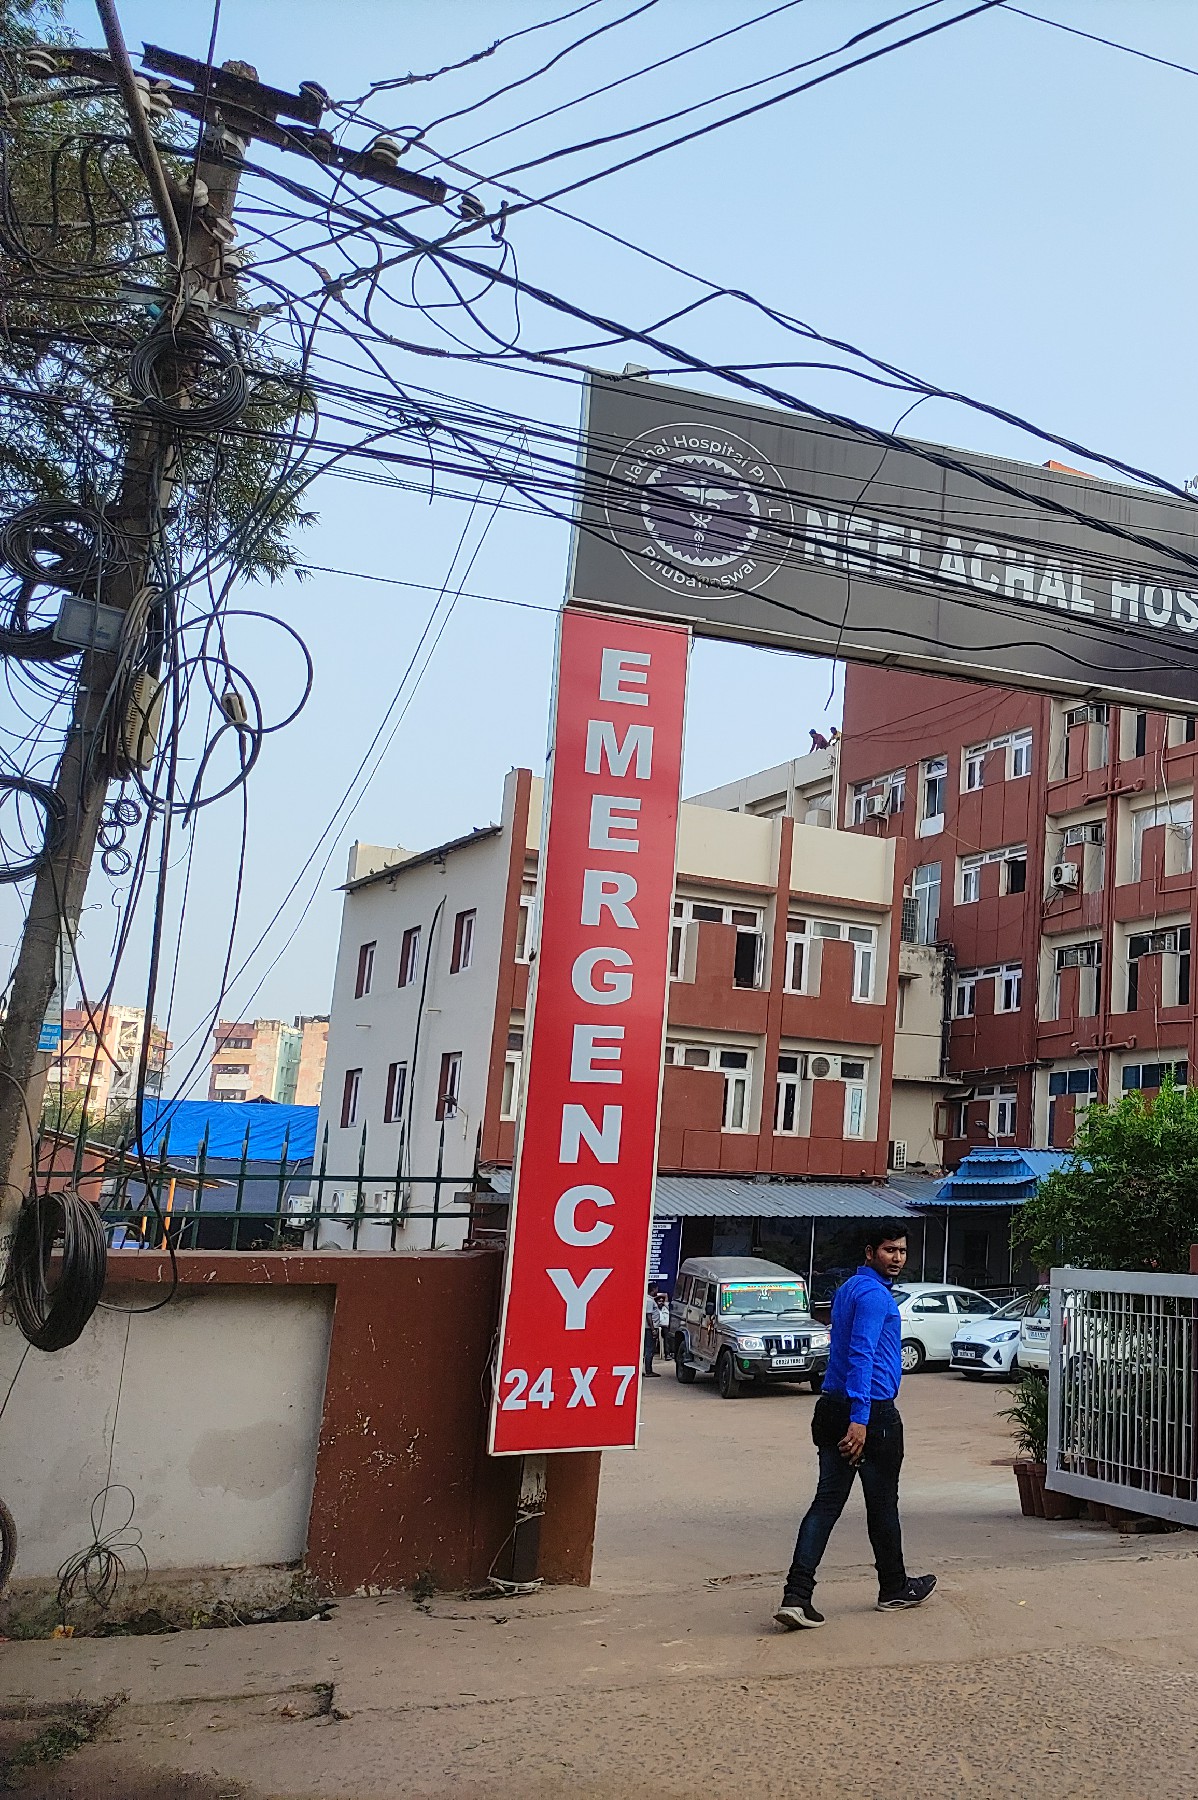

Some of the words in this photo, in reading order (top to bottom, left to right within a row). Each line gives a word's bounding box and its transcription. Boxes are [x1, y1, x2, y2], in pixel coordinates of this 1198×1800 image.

[673, 434, 751, 468] Hospital
[804, 507, 1095, 613] NEELACHAL
[546, 648, 655, 1331] EMERGENCY
[501, 1367, 554, 1411] 24
[566, 1366, 598, 1408] X
[612, 1365, 636, 1405] 7
